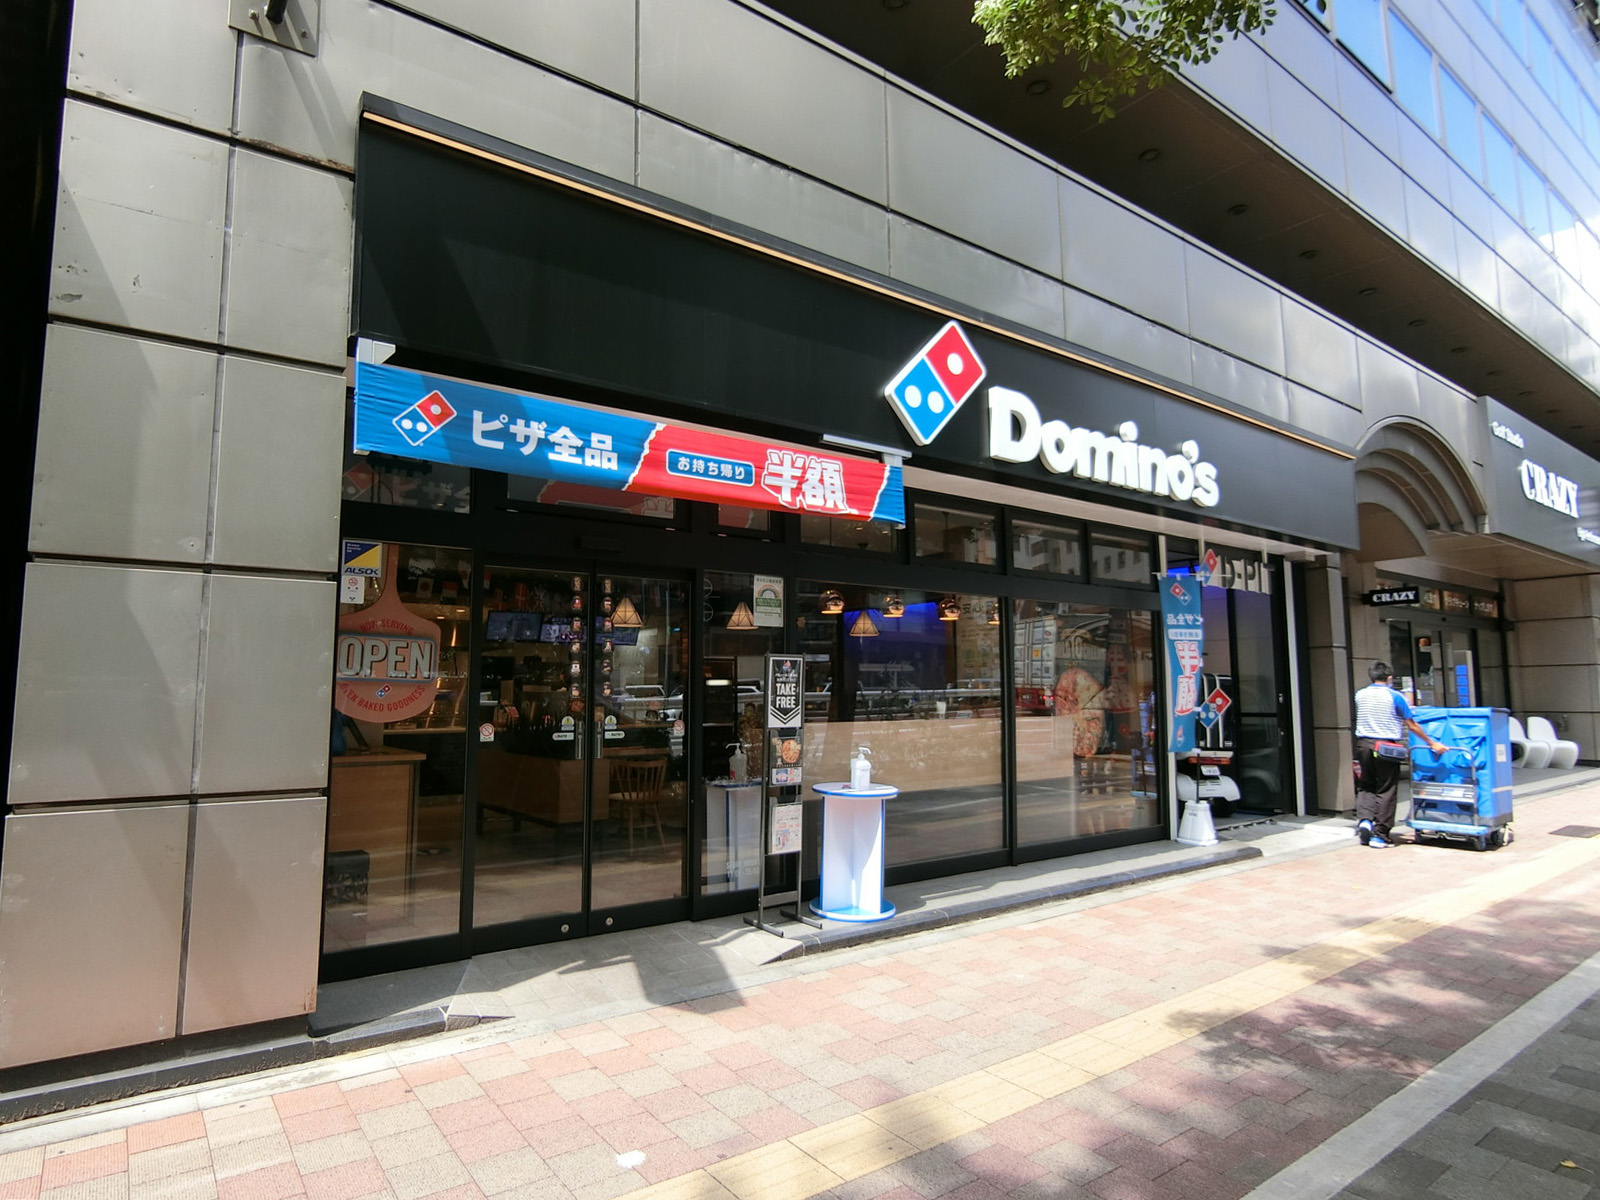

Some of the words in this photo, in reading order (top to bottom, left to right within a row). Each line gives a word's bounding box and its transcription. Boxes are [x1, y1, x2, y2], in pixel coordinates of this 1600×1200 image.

[472, 409, 618, 470] ピザ全品
[988, 385, 1220, 507] Domino's
[677, 456, 745, 480] お持ち帰り
[763, 450, 850, 513] 半額
[1521, 459, 1579, 518] CRAZY
[1372, 591, 1416, 602] CRAZY
[382, 619, 415, 635] SERVING
[339, 637, 433, 679] OPEN
[357, 698, 384, 712] BAKED
[387, 685, 426, 712] GOODNESS
[776, 683, 796, 696] TAKE
[776, 696, 796, 708] FREE
